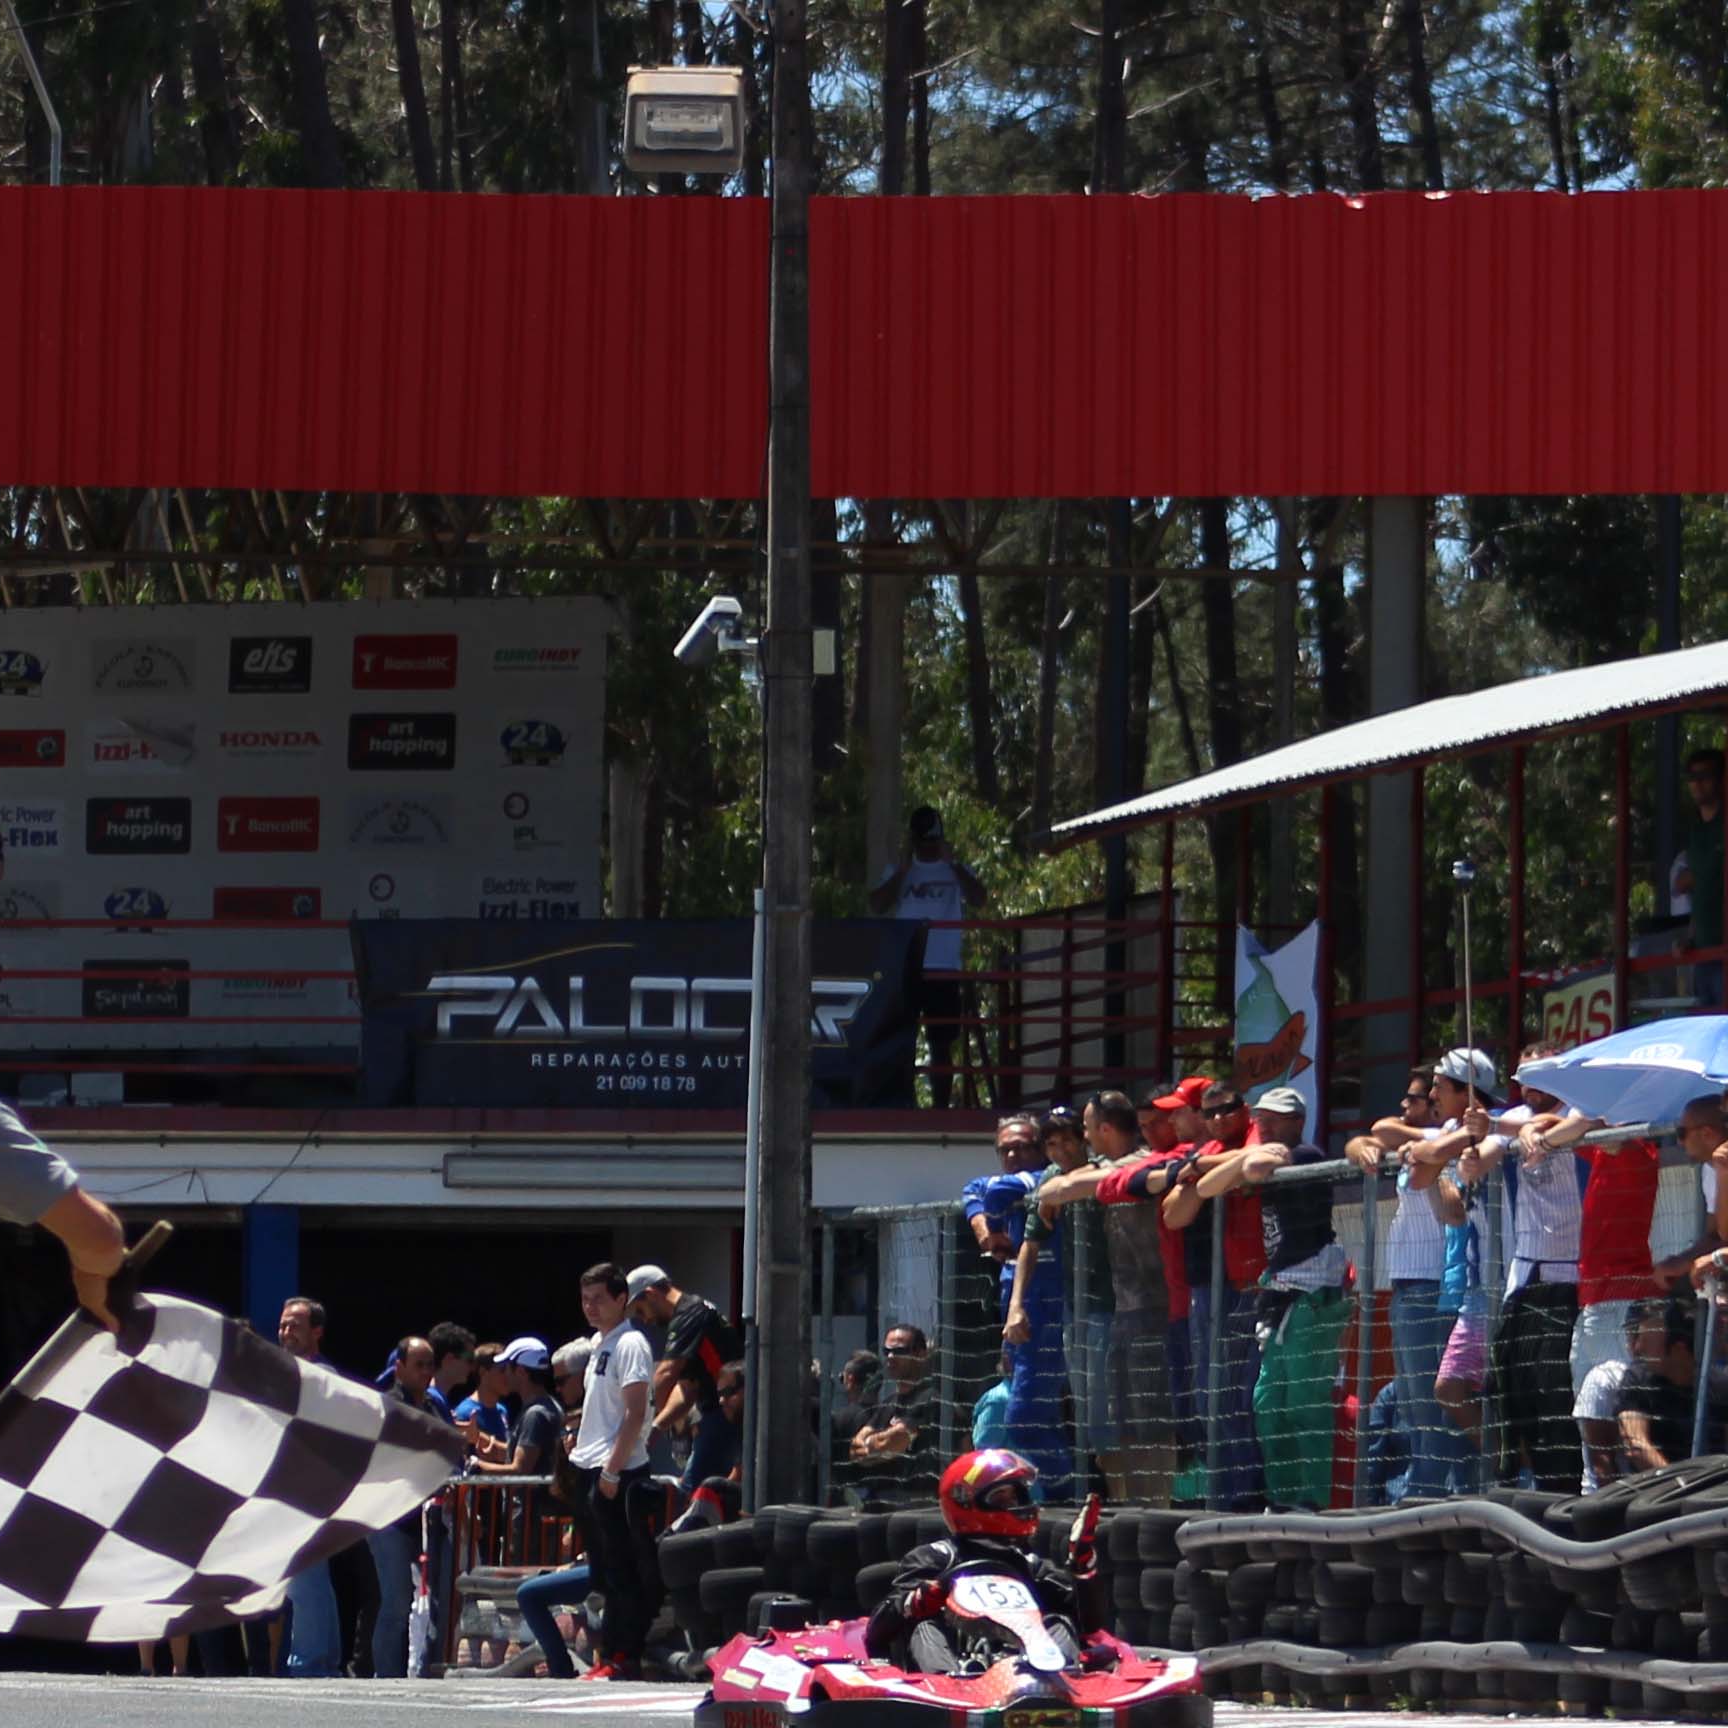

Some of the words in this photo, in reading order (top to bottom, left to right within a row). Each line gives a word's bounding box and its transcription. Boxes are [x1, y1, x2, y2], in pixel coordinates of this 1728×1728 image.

[219, 731, 321, 747] HONDA
[530, 1053, 688, 1071] REPARAÇÕES
[969, 1582, 1029, 1608] 153
